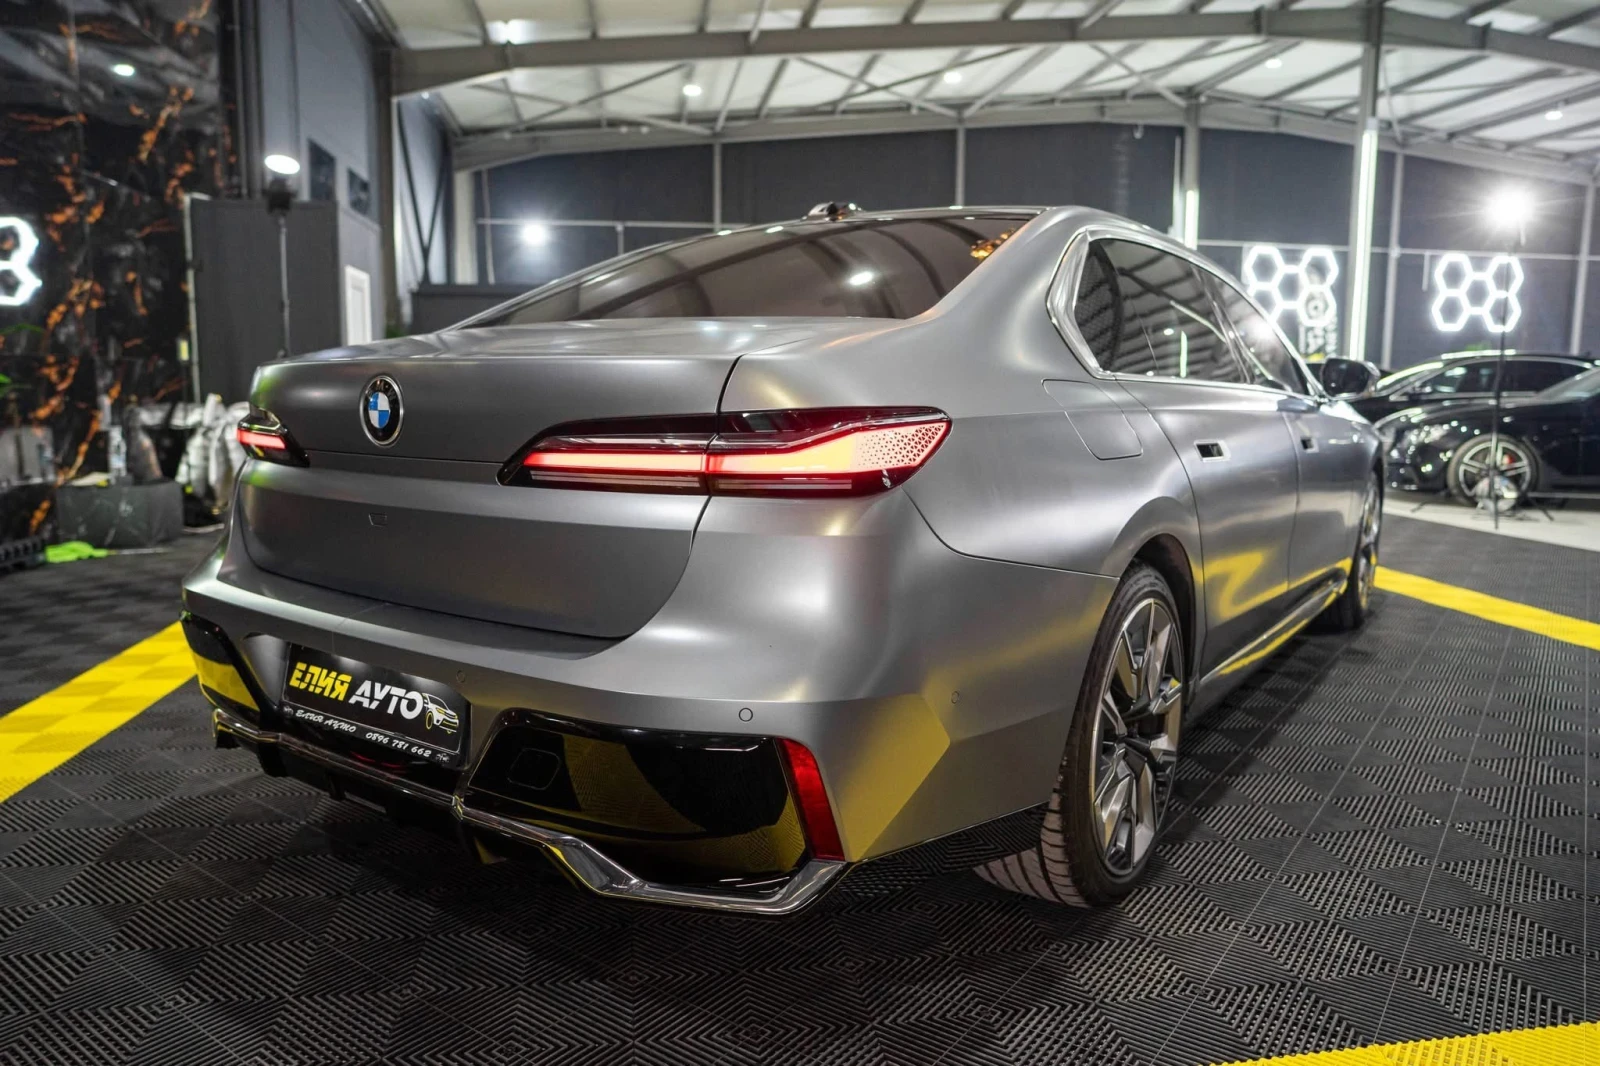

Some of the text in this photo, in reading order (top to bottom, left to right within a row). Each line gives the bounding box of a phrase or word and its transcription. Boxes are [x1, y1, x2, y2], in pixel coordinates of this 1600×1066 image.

[289, 662, 424, 720] ЕЛИЯ АУТО
[366, 732, 390, 744] 0896
[392, 739, 410, 750] 781
